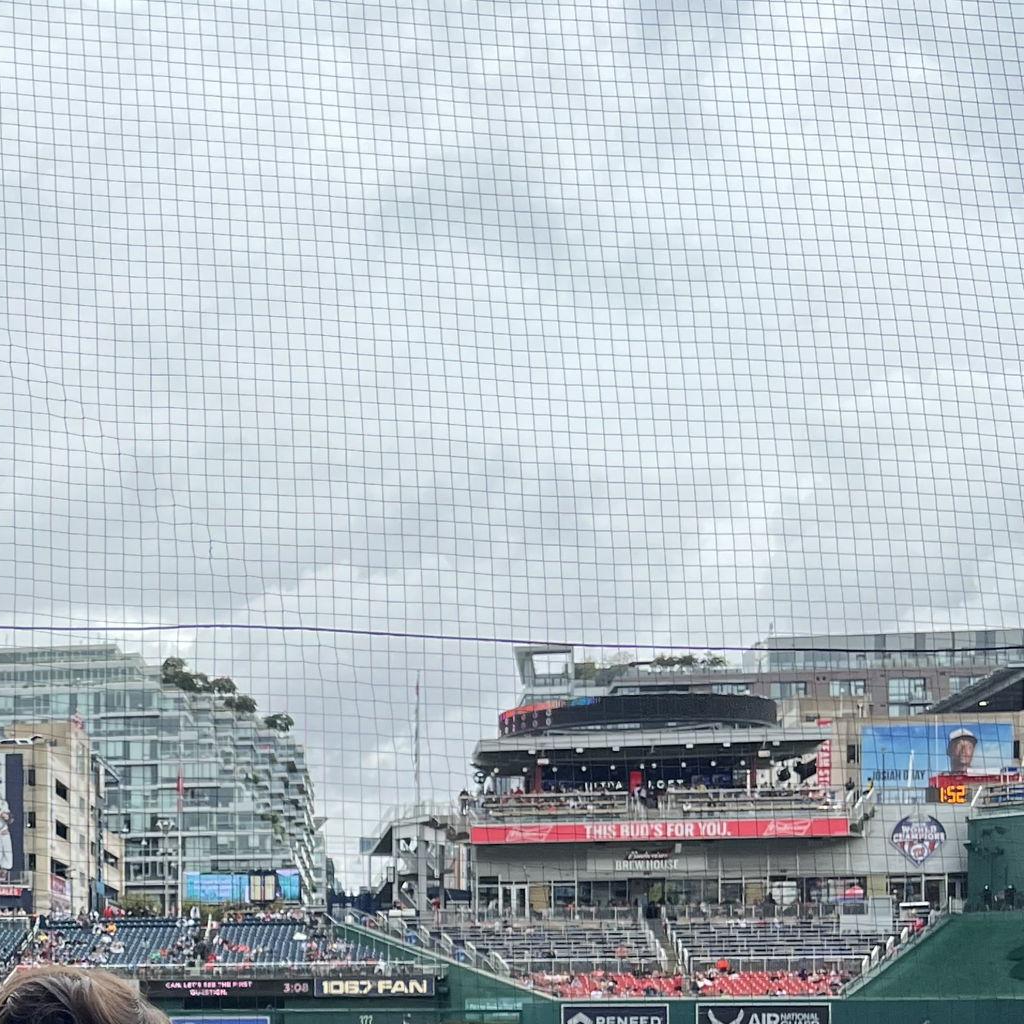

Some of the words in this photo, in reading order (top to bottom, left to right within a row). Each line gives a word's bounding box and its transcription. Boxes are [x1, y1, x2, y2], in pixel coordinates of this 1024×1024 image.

[872, 770, 901, 781] JOSIAH
[940, 785, 966, 803] 1:52
[585, 825, 616, 839] THIS
[620, 823, 663, 838] BUD'S
[667, 822, 694, 837] FOR
[697, 821, 732, 837] YOU.
[283, 983, 309, 994] 3:08
[377, 980, 427, 994] FAN
[780, 1012, 819, 1021] NATIONAL
